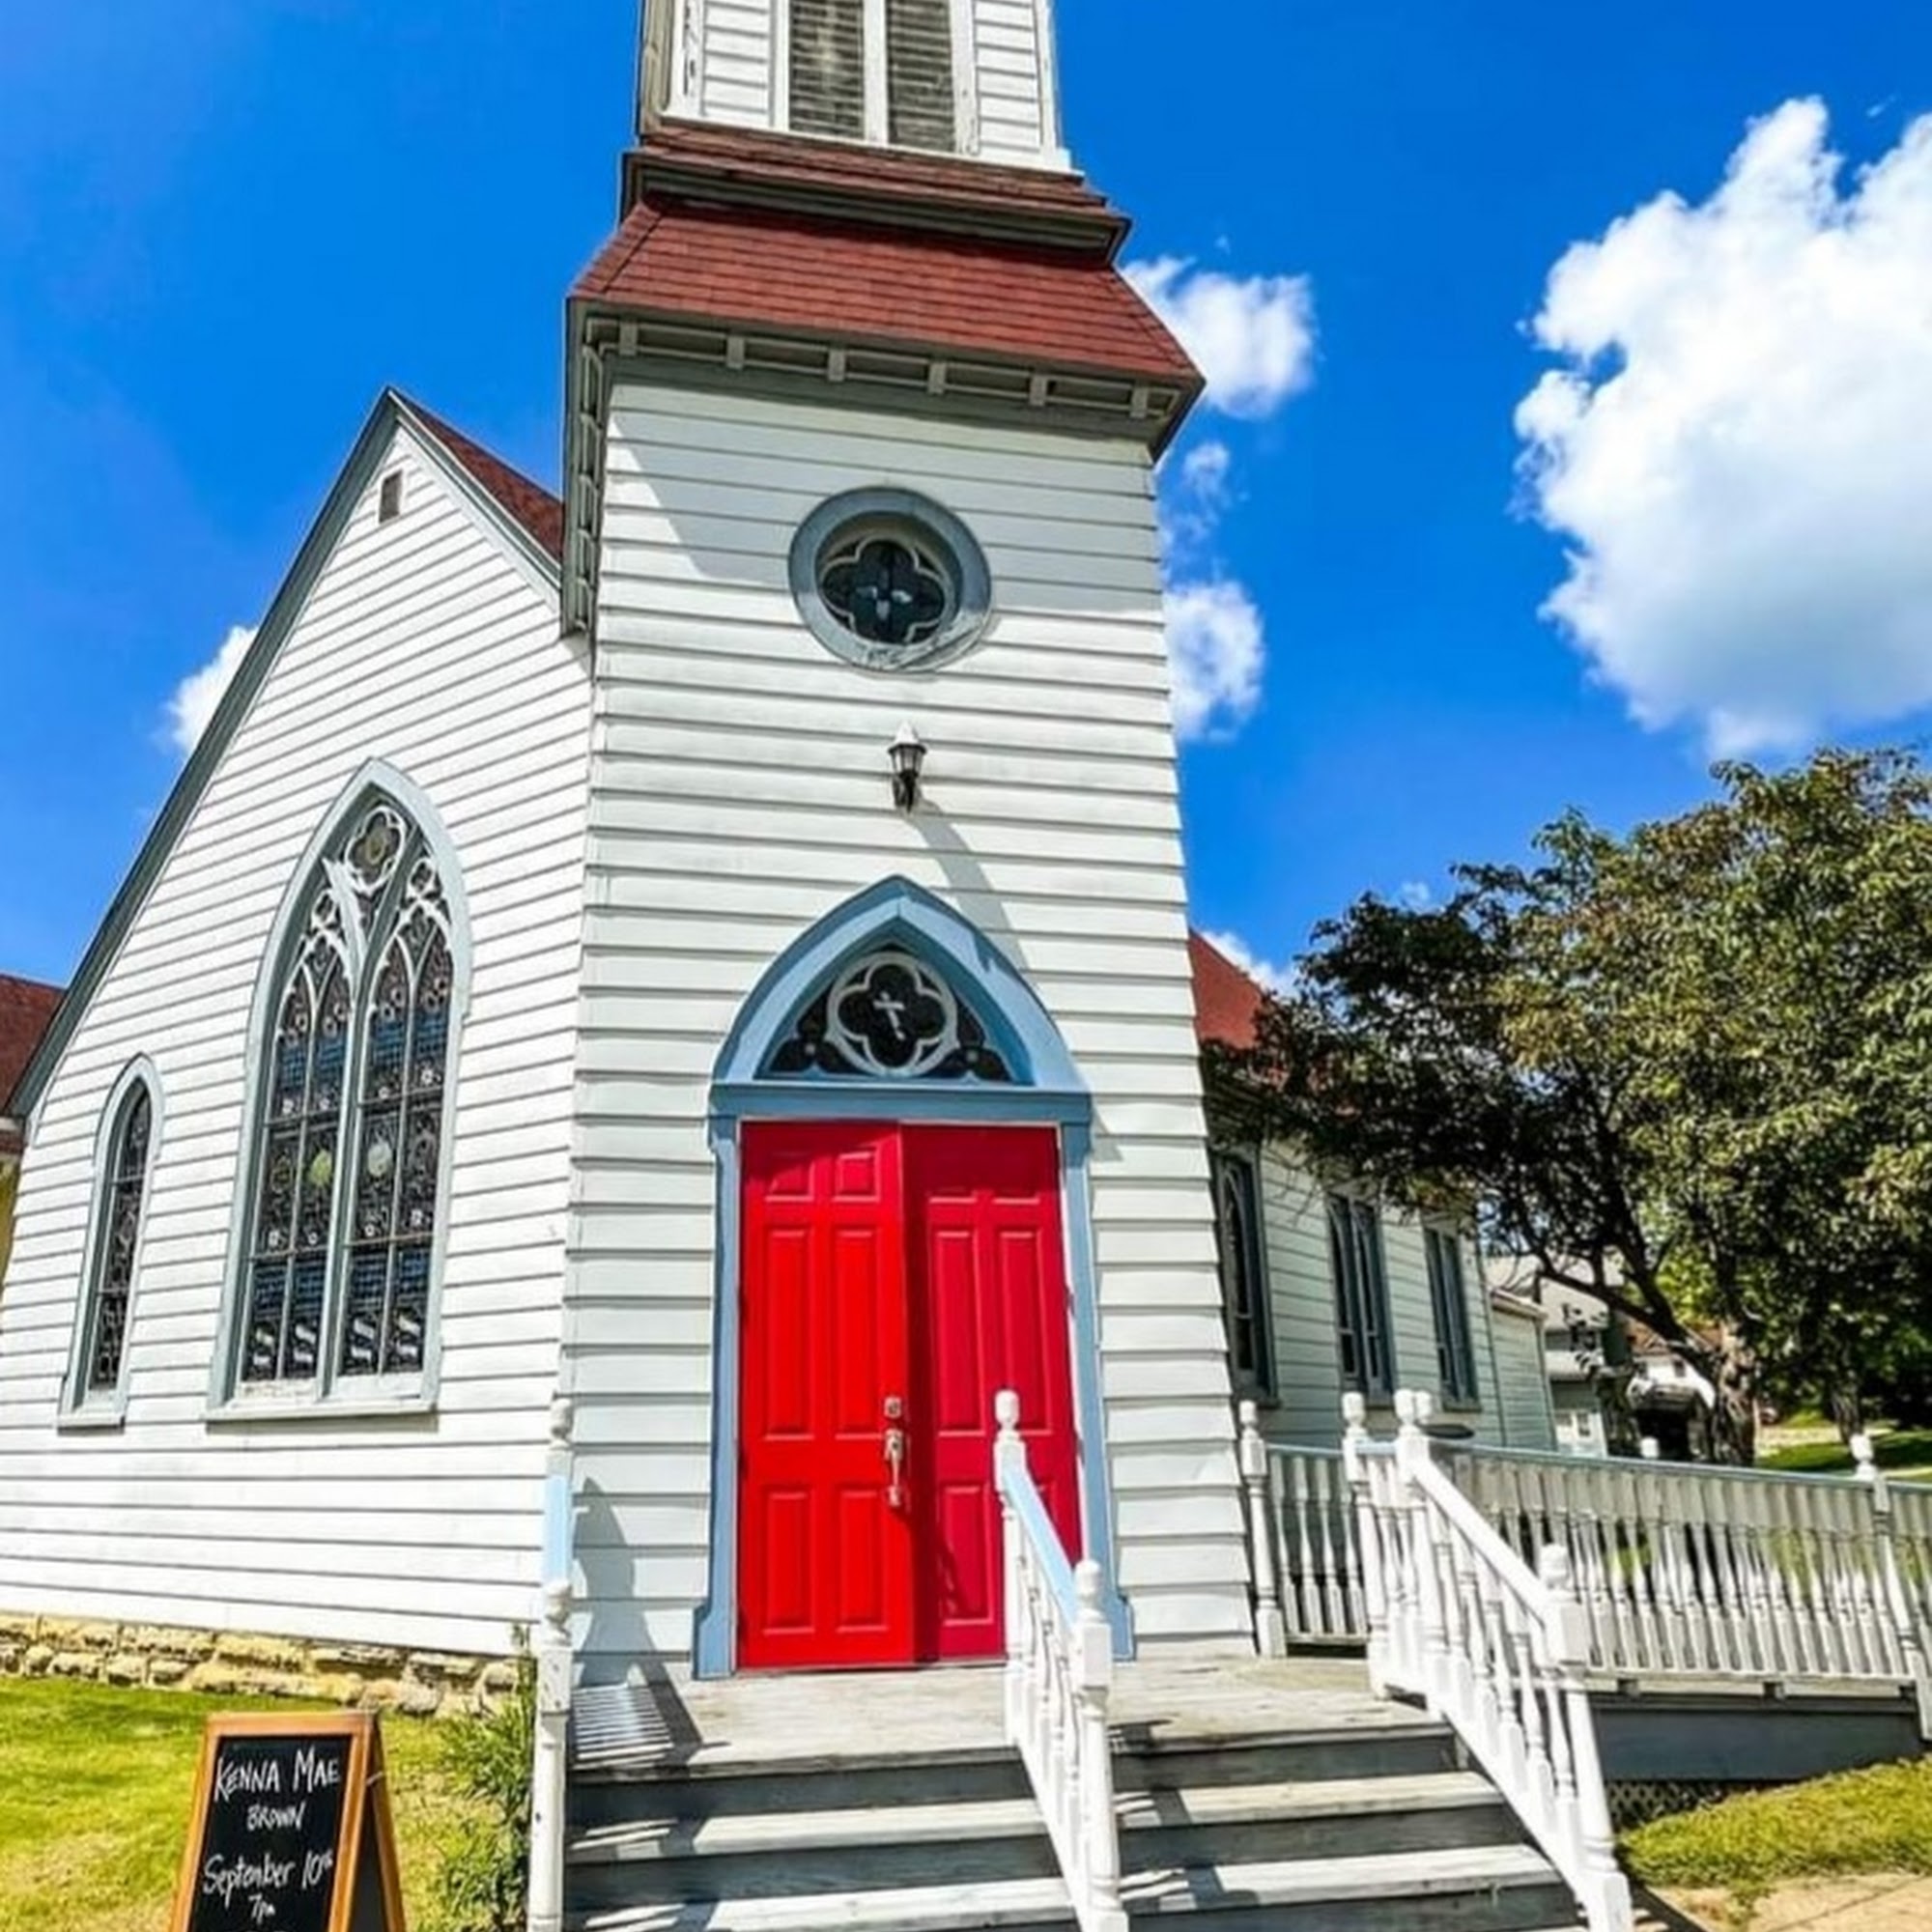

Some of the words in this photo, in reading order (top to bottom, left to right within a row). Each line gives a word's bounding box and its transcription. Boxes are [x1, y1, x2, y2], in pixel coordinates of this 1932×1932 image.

[213, 1757, 280, 1803] KENNA
[294, 1746, 340, 1793] MAE
[246, 1802, 305, 1831] BROWN
[203, 1853, 294, 1909] September
